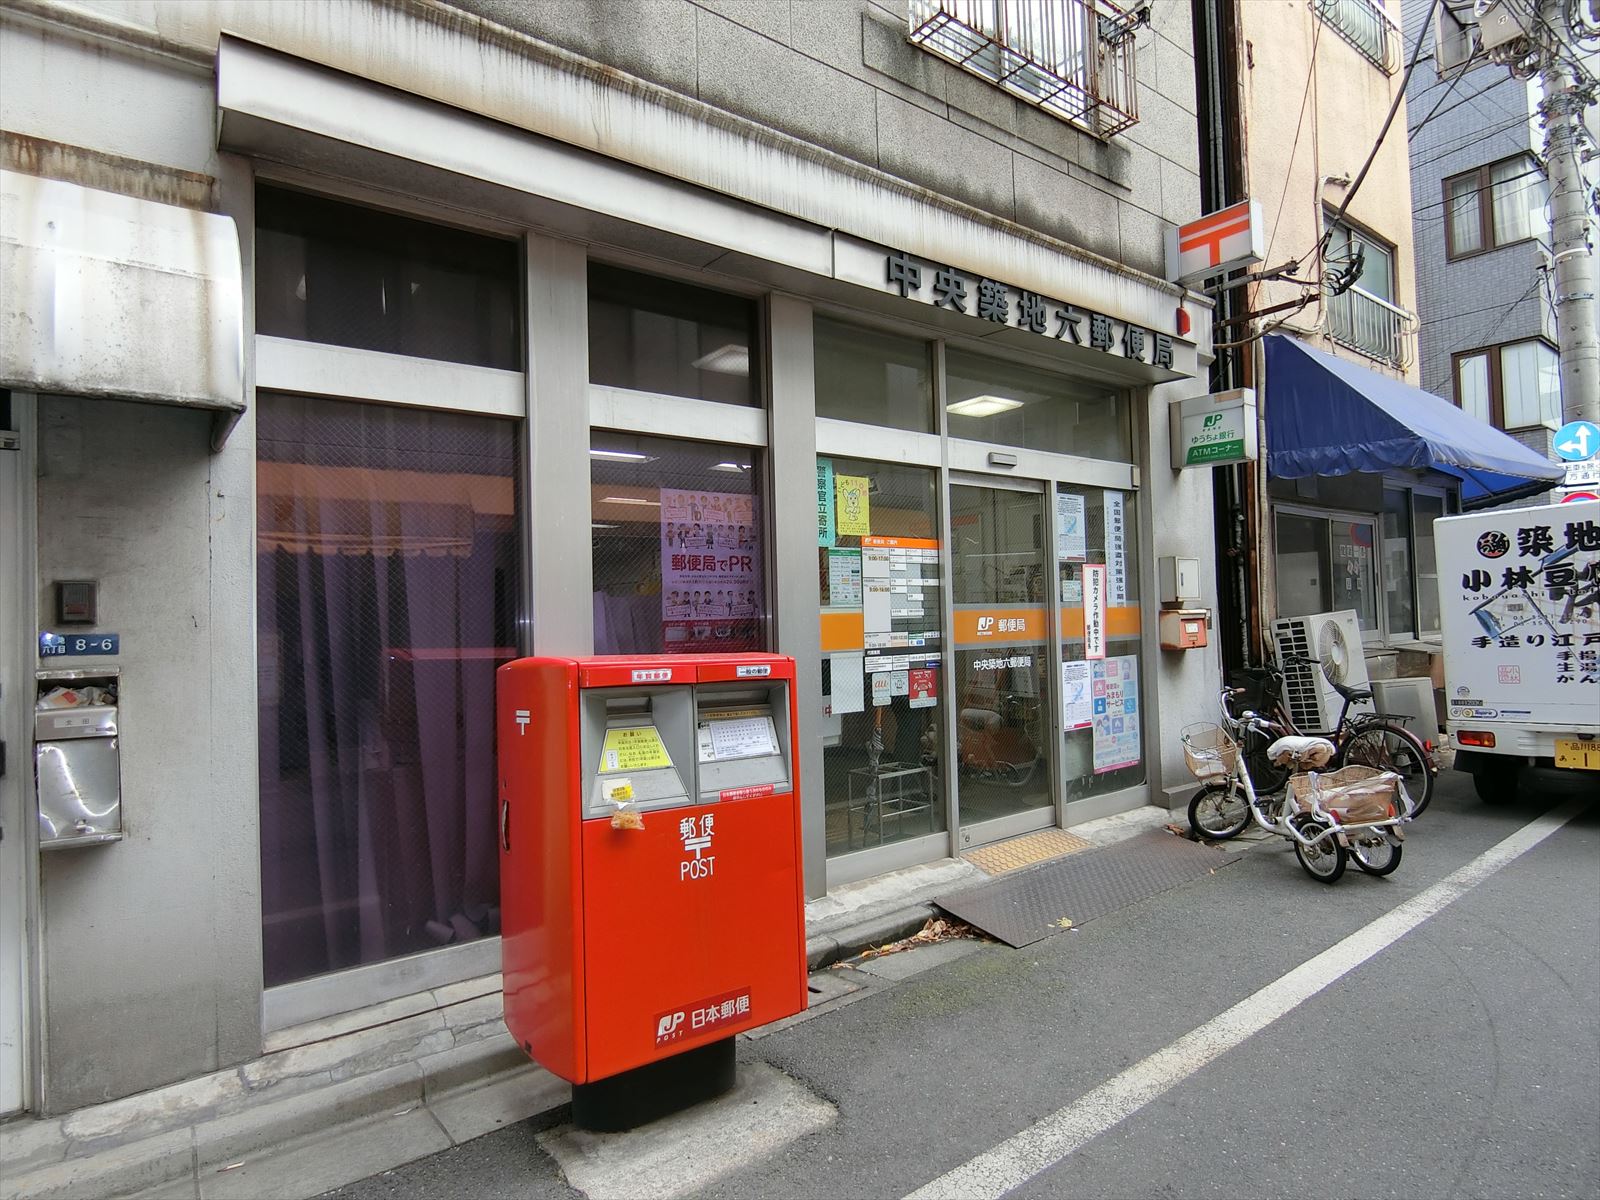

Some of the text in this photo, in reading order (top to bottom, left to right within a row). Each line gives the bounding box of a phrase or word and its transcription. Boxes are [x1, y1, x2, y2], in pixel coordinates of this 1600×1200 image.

[888, 254, 1174, 370] 中央築地六郵便局
[1191, 430, 1235, 445] ゆうちょ銀行
[1192, 444, 1239, 457] ATMコーナー
[816, 465, 828, 539] 警察官立寄所
[1517, 520, 1600, 557] 築地
[671, 553, 753, 572] 郵便局でPR
[997, 618, 1026, 632] 郵便局
[75, 638, 112, 651] 8-6
[973, 655, 1032, 671] 中央築地六郵便局
[679, 813, 715, 840] 郵便
[680, 856, 716, 881] POST
[691, 994, 750, 1029] 日本郵便
[656, 1030, 683, 1044] POST
